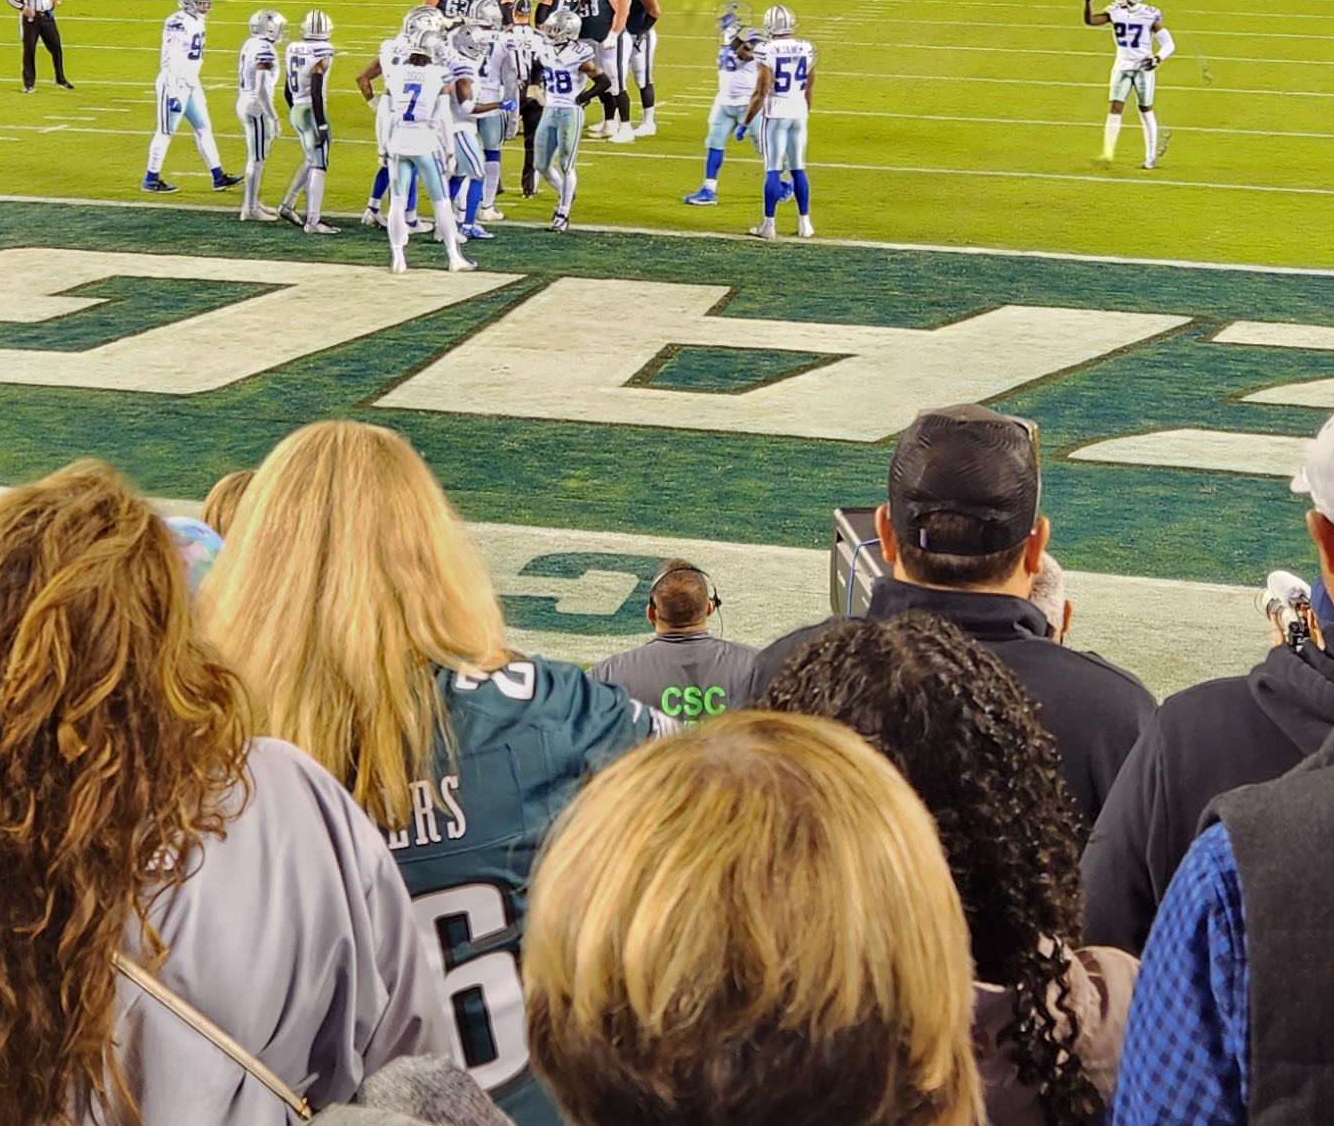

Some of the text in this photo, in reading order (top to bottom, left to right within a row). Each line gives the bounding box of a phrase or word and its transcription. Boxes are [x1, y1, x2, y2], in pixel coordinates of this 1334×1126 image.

[187, 33, 206, 61] 9
[1113, 22, 1144, 49] 27
[774, 56, 807, 92] 54
[402, 83, 423, 122] 7
[661, 685, 707, 717] CSC
